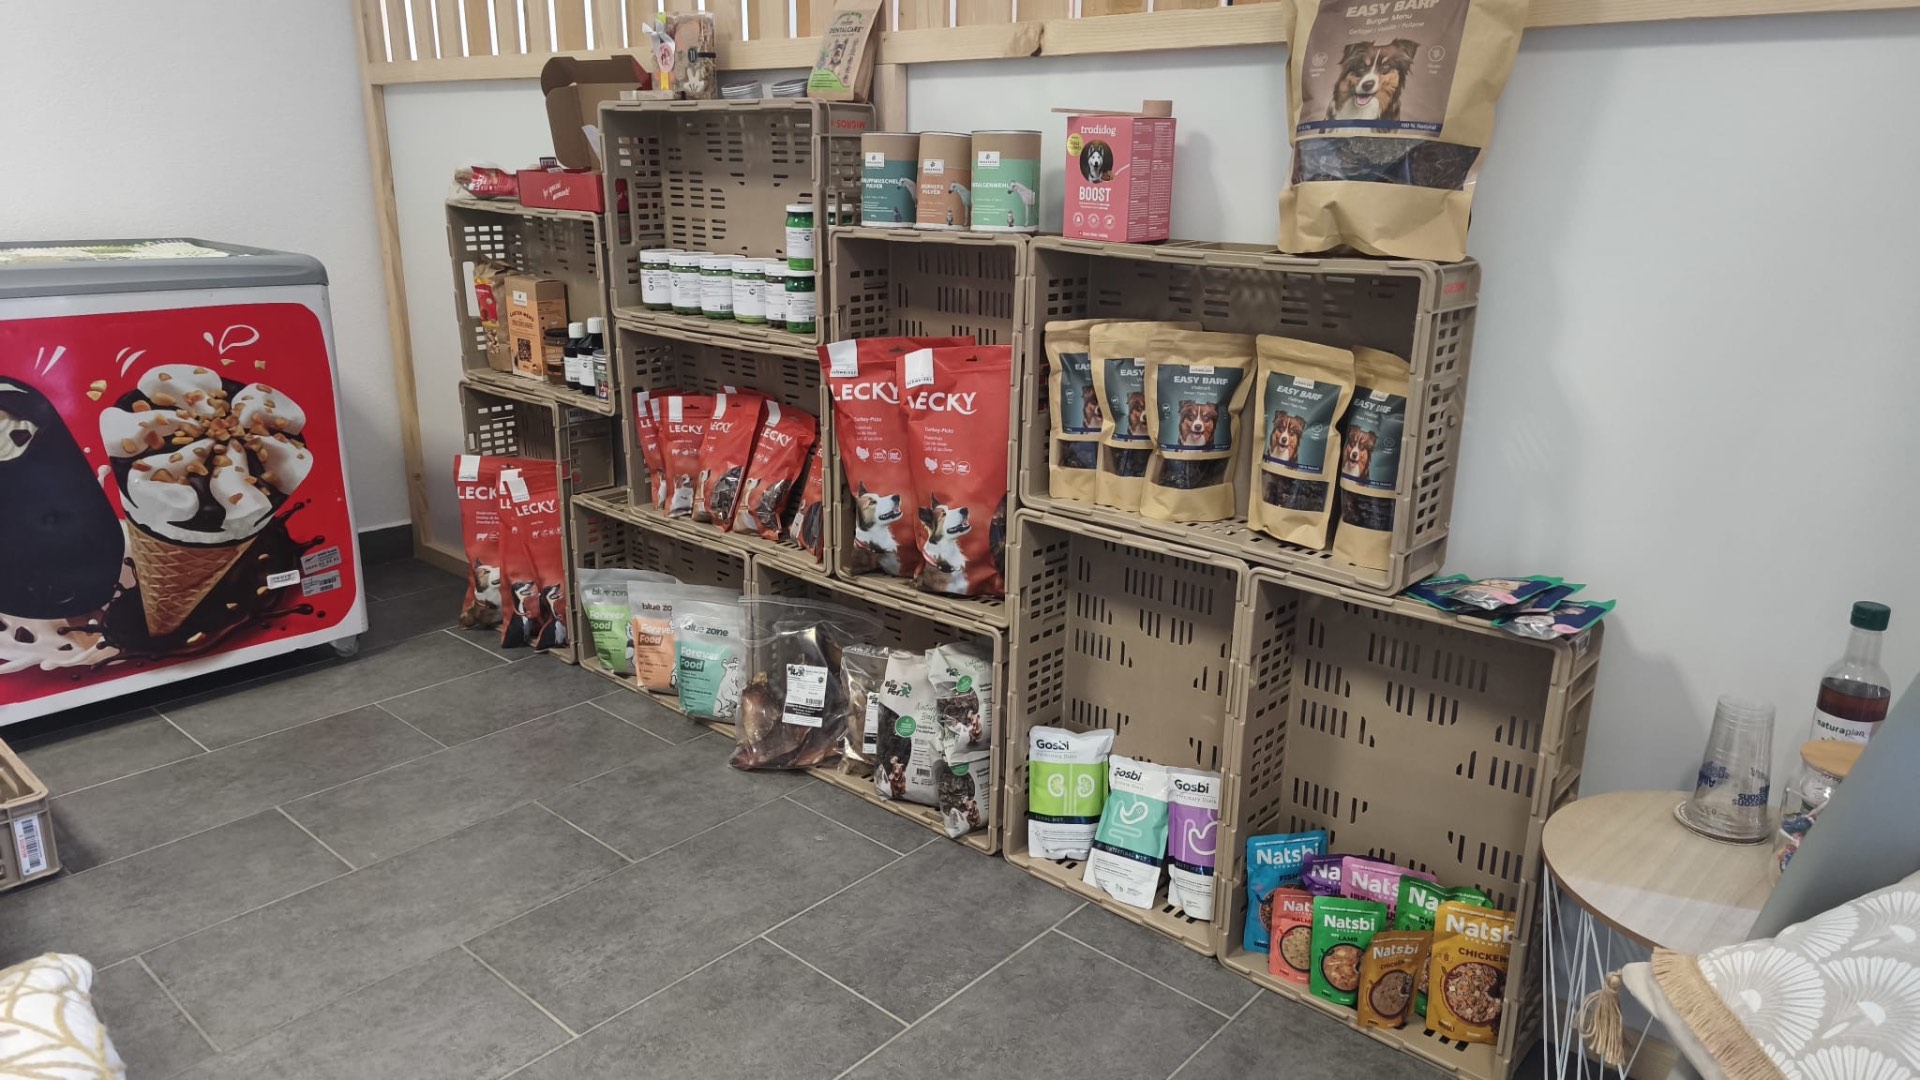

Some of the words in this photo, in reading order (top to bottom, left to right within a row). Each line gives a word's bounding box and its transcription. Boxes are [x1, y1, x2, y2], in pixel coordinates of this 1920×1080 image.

[1346, 3, 1390, 18] EASY
[1079, 186, 1112, 202] BOOST
[1174, 375, 1200, 384] EASY
[1202, 377, 1229, 386] BARF
[830, 382, 900, 404] LECKY
[1276, 385, 1299, 397] EASY
[1299, 391, 1323, 402] BARF
[907, 392, 977, 415] LECKY
[668, 424, 704, 435] LECKY
[458, 486, 498, 501] LECK
[516, 499, 558, 518] LECKY
[592, 587, 609, 597] blue
[590, 609, 625, 619] Forever
[642, 602, 661, 611] blue
[590, 621, 611, 630] Food
[640, 623, 675, 634] Forever
[685, 624, 705, 633] blue
[706, 627, 729, 637] zone
[639, 634, 661, 644] Food
[680, 646, 720, 661] Forever
[680, 658, 704, 670] Food
[884, 680, 898, 690] Big
[1816, 719, 1865, 737] naturaplan
[1036, 739, 1070, 751] Gosbi
[1113, 767, 1143, 782] Gosbi
[1174, 779, 1210, 794] Gosbi
[1351, 871, 1399, 897] Nats
[1324, 914, 1375, 931] Natsbi
[1445, 914, 1515, 943] Natsb
[1373, 944, 1419, 960] Natsbi
[1458, 947, 1508, 963] CHICKEN
[1380, 960, 1404, 970] CHICKEN
